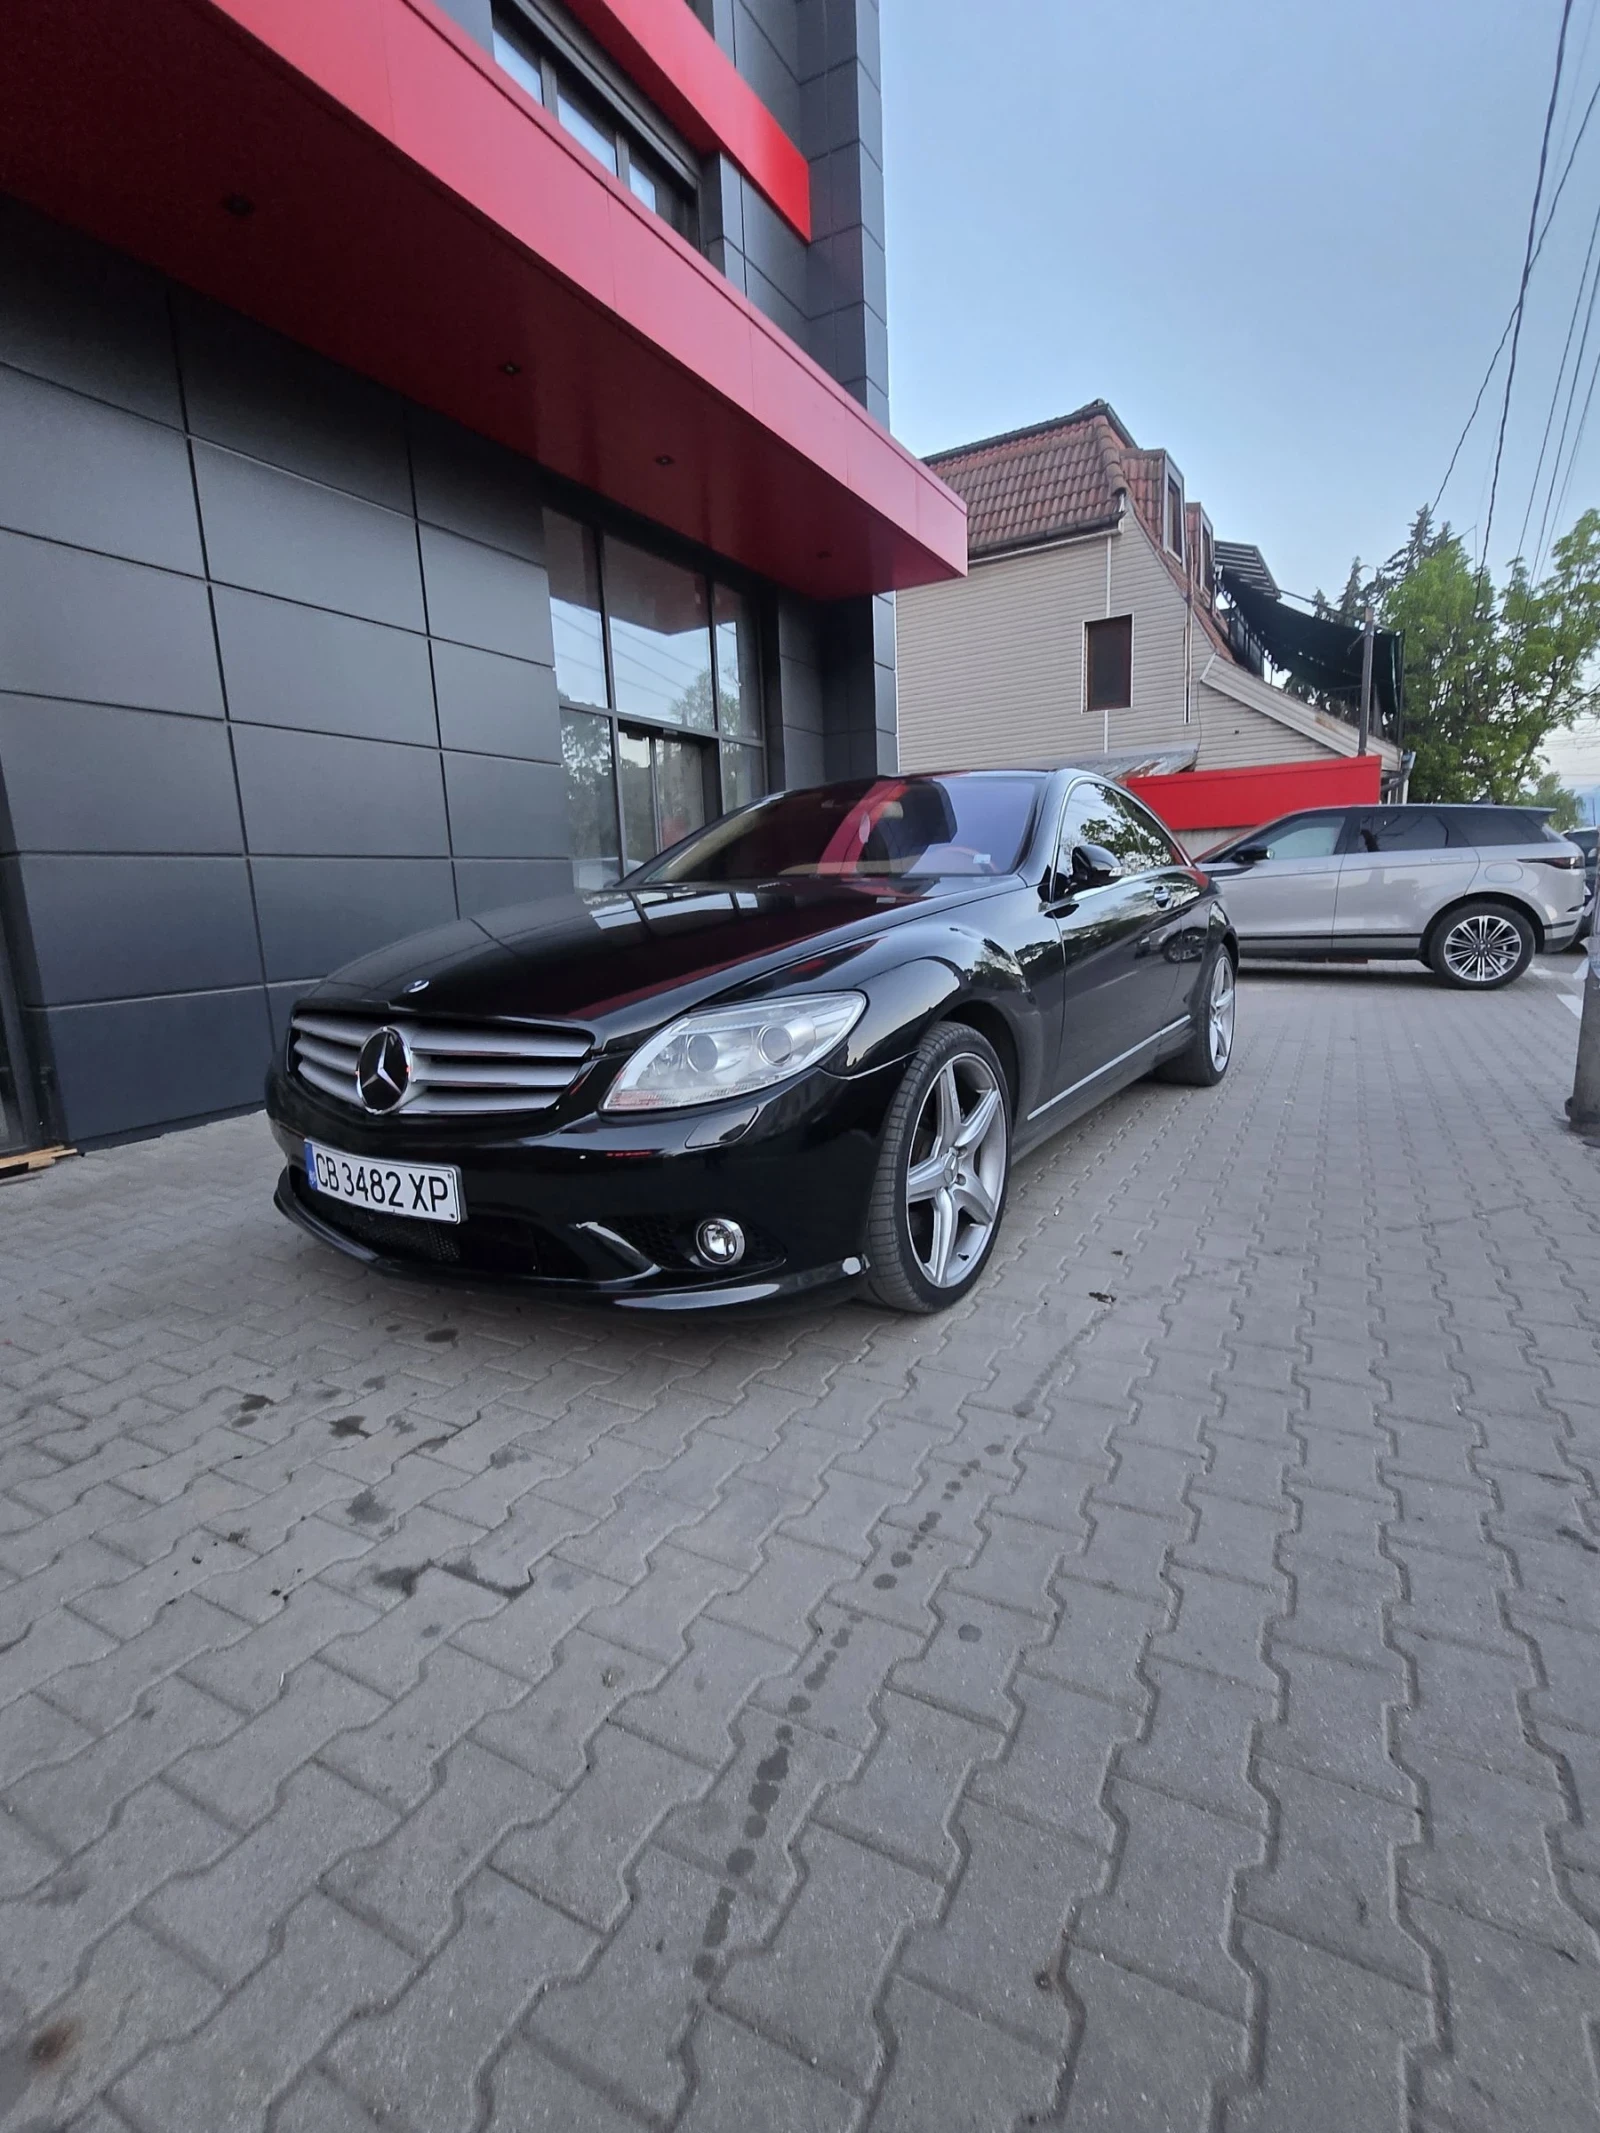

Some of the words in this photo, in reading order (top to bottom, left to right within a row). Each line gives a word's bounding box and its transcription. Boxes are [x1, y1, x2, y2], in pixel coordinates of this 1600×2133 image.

[316, 1153, 340, 1192] CB
[341, 1162, 404, 1208] 3482
[408, 1173, 448, 1212] XP
